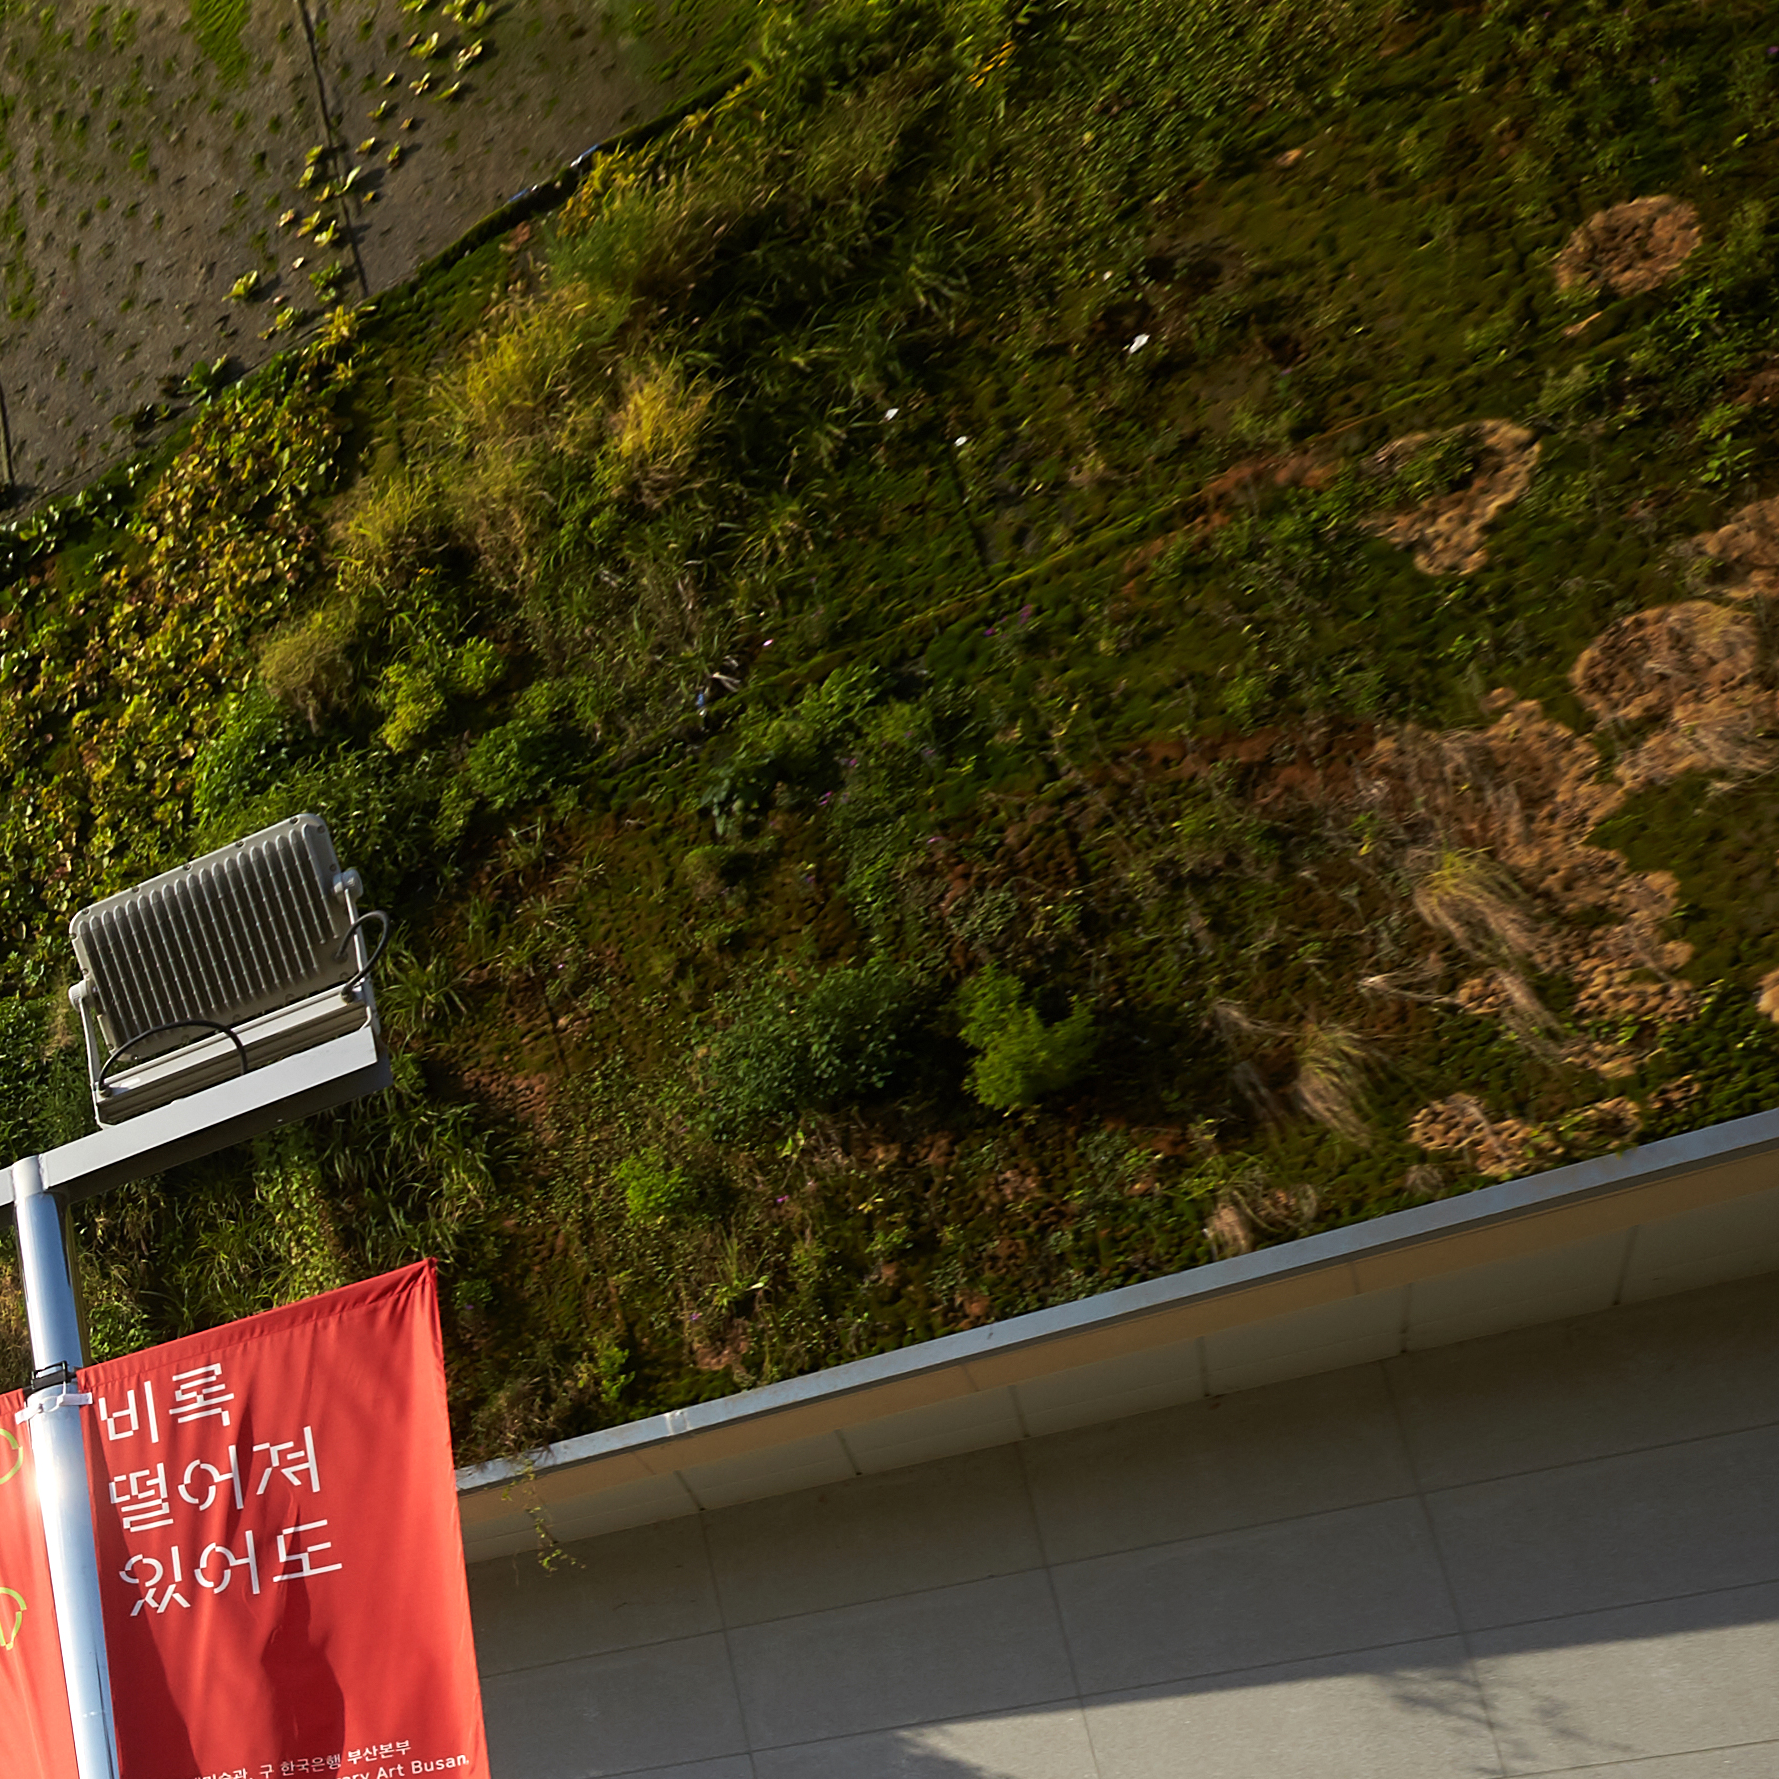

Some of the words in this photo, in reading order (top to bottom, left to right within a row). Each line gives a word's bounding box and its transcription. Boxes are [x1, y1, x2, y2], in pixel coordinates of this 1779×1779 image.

[98, 1363, 234, 1443] 비록
[109, 1426, 320, 1532] 떨어져
[119, 1519, 343, 1617] 있어도
[259, 1763, 275, 1779] 구
[280, 1753, 342, 1777] 한국은행
[346, 1739, 412, 1764] 부산본부
